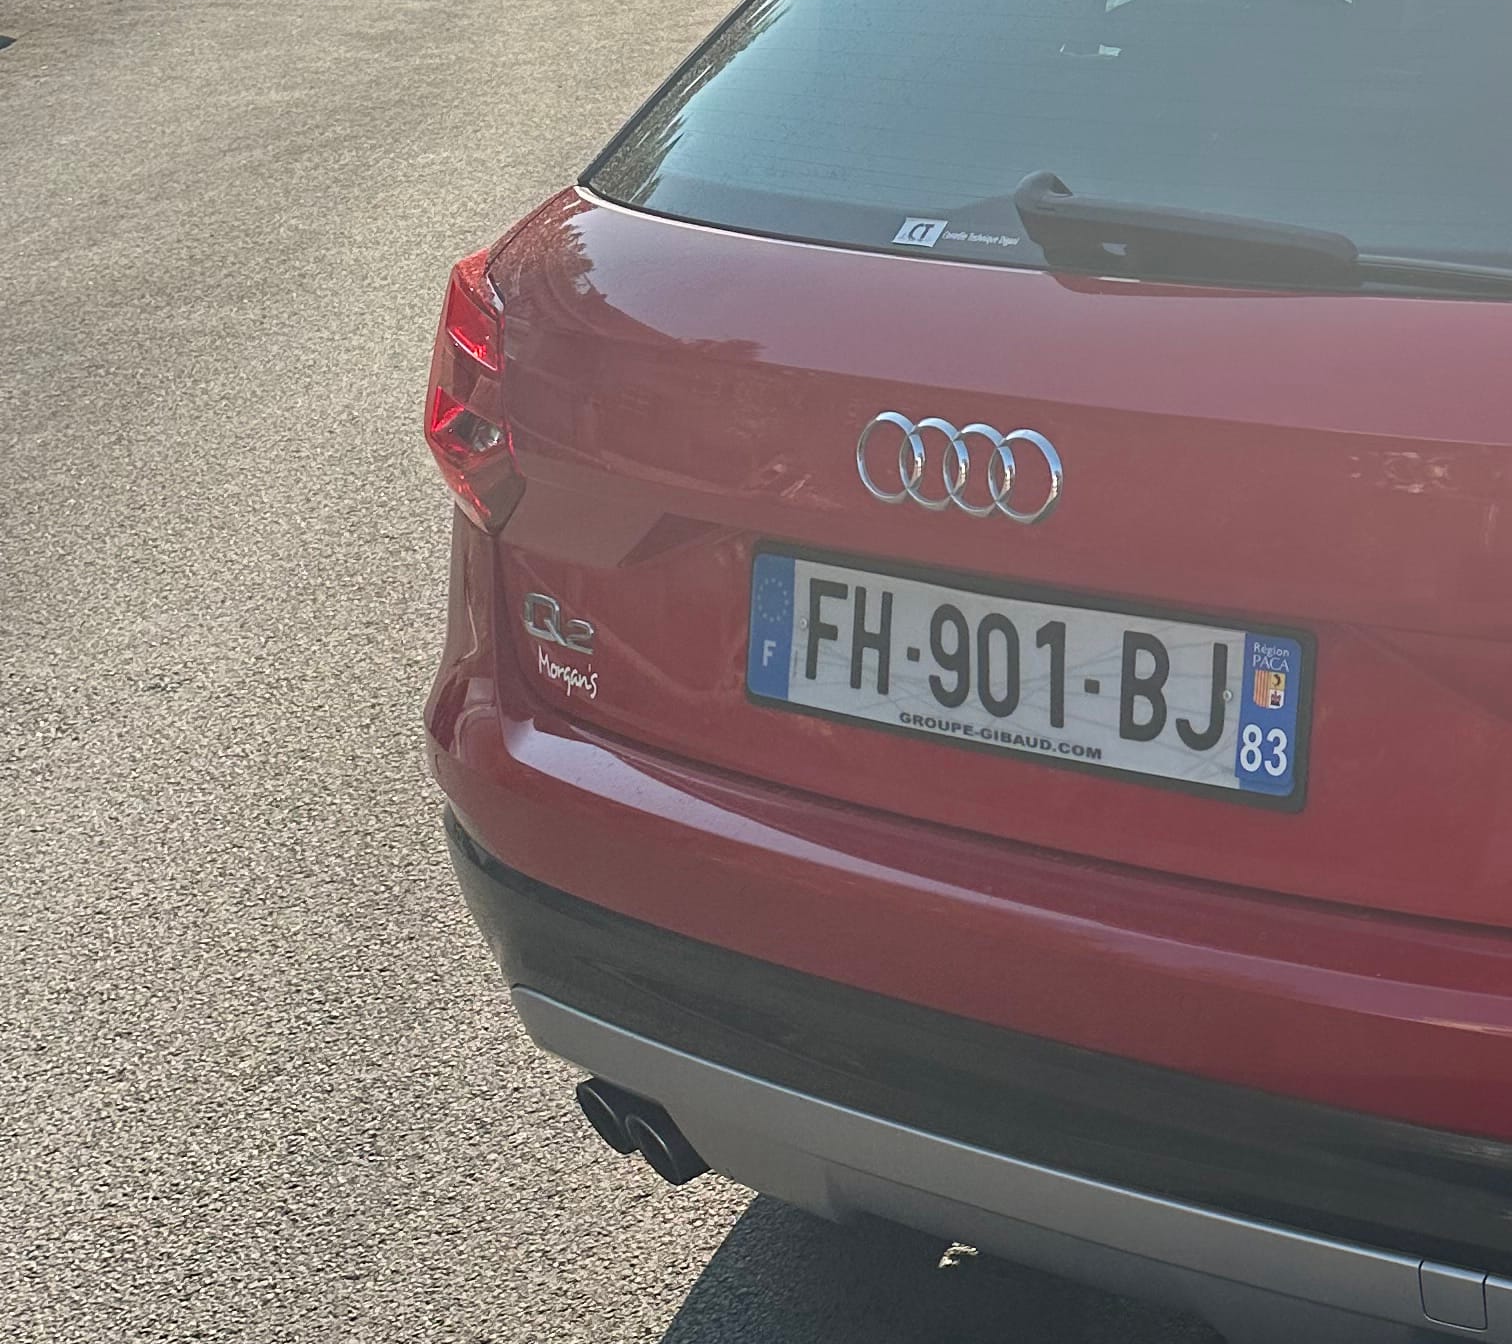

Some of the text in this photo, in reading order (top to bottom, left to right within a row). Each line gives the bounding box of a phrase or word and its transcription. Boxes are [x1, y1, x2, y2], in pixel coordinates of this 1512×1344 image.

[524, 593, 594, 654] Q2
[538, 645, 598, 699] Morgan's
[763, 640, 776, 667] F
[806, 578, 1228, 751] FH-901-BJ
[1252, 655, 1289, 673] PACA
[900, 711, 1102, 760] GROUPE-GIBAUD.COM
[1240, 724, 1288, 777] 83
